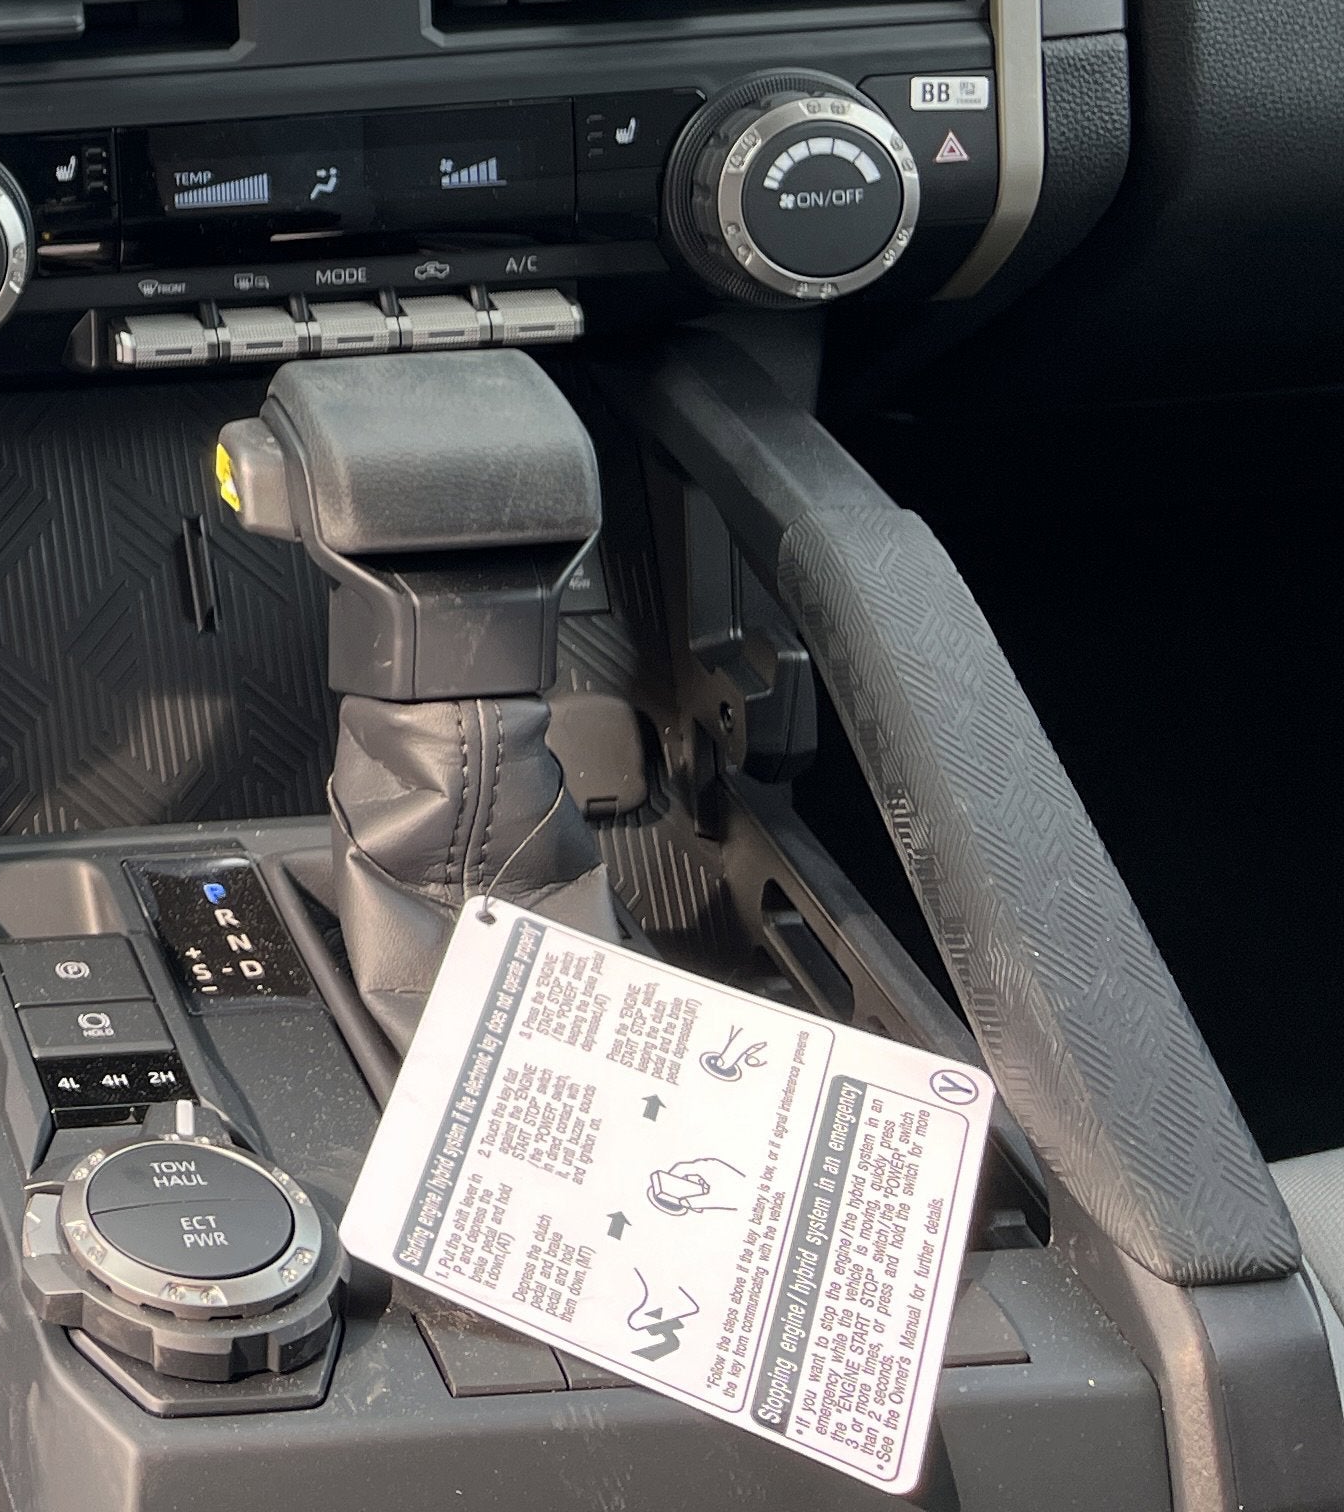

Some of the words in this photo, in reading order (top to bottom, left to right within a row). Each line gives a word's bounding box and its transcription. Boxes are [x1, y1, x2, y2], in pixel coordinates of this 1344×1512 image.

[173, 169, 212, 187] TEMP
[796, 188, 865, 209] ON/OFF
[505, 254, 539, 274] A/C
[315, 266, 367, 286] MODE
[156, 281, 187, 295] FRONT
[214, 908, 240, 928] R
[226, 933, 253, 952] N
[192, 963, 212, 981] S
[239, 960, 263, 979] D
[495, 991, 514, 1010] not
[83, 1028, 114, 1037] HOLD
[485, 1009, 507, 1033] does
[476, 1033, 503, 1053] key
[58, 1076, 81, 1090] 4L
[102, 1073, 129, 1087] 4H
[148, 1070, 176, 1084] 2H
[462, 1051, 492, 1096] electronic
[455, 1095, 477, 1113] the
[869, 1097, 884, 1114] an
[828, 1081, 862, 1151] emergency
[863, 1116, 880, 1129] in
[914, 1108, 931, 1137] more
[442, 1122, 467, 1158] system
[878, 1118, 896, 1151] press
[856, 1132, 875, 1172] system
[906, 1139, 923, 1158] for
[149, 1159, 197, 1173] TOW
[822, 1155, 841, 1175] an
[868, 1153, 891, 1192] quickly
[153, 1173, 208, 1188] HAUL
[466, 1172, 483, 1185] in
[812, 1176, 836, 1193] in
[897, 1162, 919, 1197] switch
[458, 1182, 479, 1209] lever
[477, 1187, 494, 1205] the
[494, 1181, 513, 1205] hold
[845, 1173, 866, 1210] hybrid
[452, 1207, 470, 1232] shift
[489, 1203, 506, 1225] and
[805, 1196, 831, 1245] system
[858, 1199, 881, 1241] moving,
[892, 1201, 911, 1221] the
[923, 1197, 944, 1235] details.
[180, 1215, 217, 1231] ECT
[464, 1205, 488, 1244] depress
[182, 1231, 230, 1248] PWR
[398, 1225, 434, 1266] Starting
[444, 1231, 462, 1251] the
[480, 1224, 502, 1255] pedal
[884, 1221, 906, 1250] hold
[437, 1248, 456, 1270] Put
[458, 1242, 475, 1265] and
[849, 1241, 869, 1257] is
[912, 1239, 935, 1279] further
[467, 1255, 489, 1284] brake
[829, 1421, 848, 1443] the
[848, 1311, 870, 1356] START
[897, 1110, 915, 1145] switch
[883, 1253, 900, 1279] and
[824, 1280, 842, 1301] the
[837, 1258, 864, 1302] vehicle
[875, 1281, 894, 1317] press
[907, 1282, 926, 1302] for
[819, 1304, 839, 1332] stop
[834, 1307, 854, 1329] the
[871, 1317, 886, 1334] or
[898, 1304, 921, 1350] Manual
[813, 1334, 830, 1349] to
[829, 1332, 848, 1364] while
[807, 1352, 826, 1383] want
[857, 1339, 883, 1376] times,
[757, 1356, 798, 1423] Stopping
[872, 1354, 894, 1406] seconds.
[887, 1355, 912, 1405] Owner's
[800, 1388, 817, 1415] you
[813, 1367, 842, 1436] emergency
[854, 1382, 872, 1415] more
[794, 1414, 811, 1429] If
[850, 1416, 864, 1433] or
[866, 1409, 882, 1423] 2
[882, 1408, 900, 1431] the
[859, 1425, 879, 1456] than
[874, 1435, 895, 1463] See
